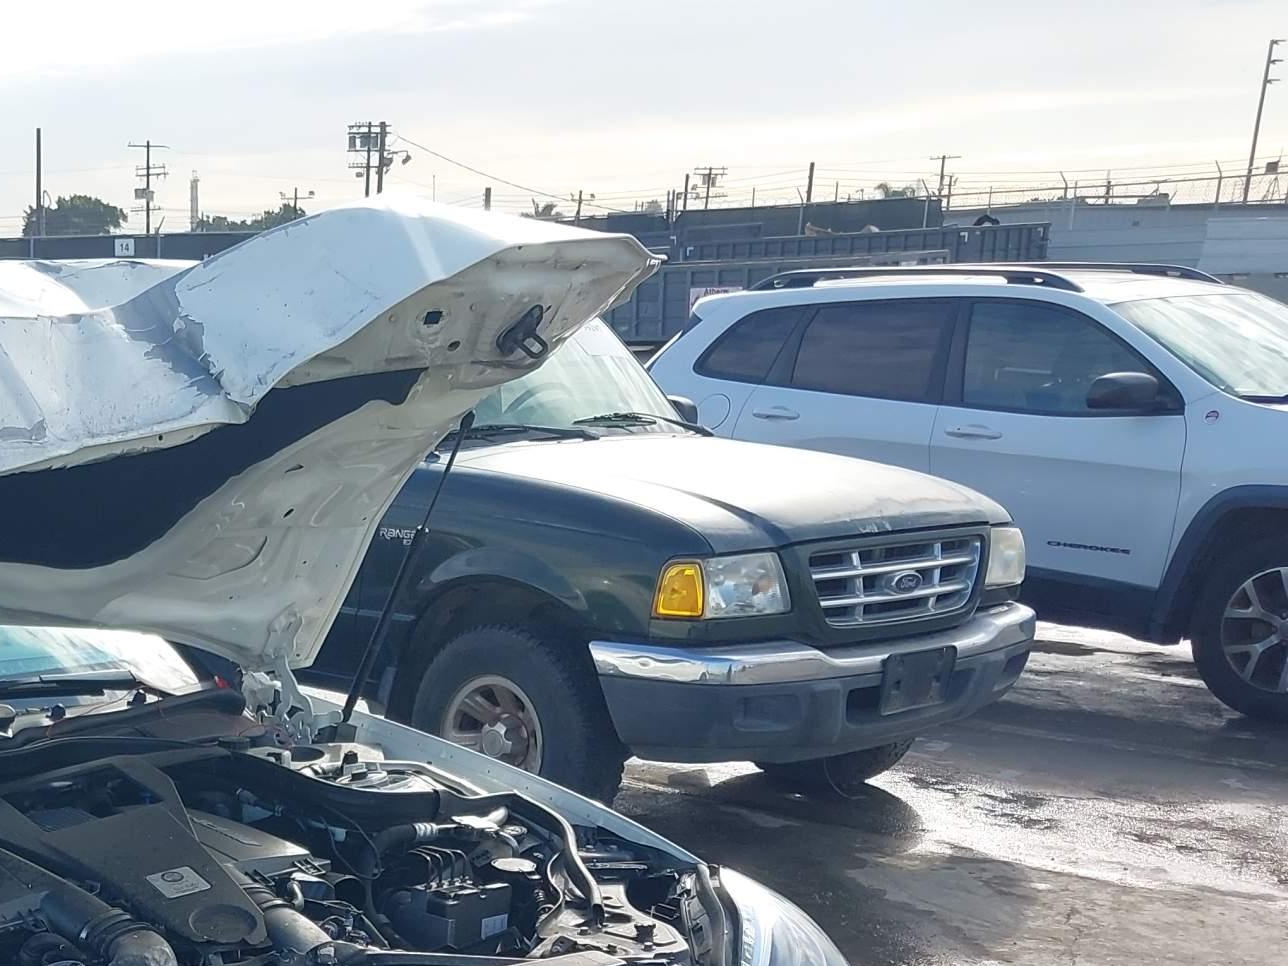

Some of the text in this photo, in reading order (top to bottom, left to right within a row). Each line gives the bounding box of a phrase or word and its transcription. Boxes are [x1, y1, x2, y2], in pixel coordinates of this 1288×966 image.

[120, 243, 129, 253] 14
[379, 527, 418, 540] RANGE
[1047, 541, 1130, 555] CHEROKEE
